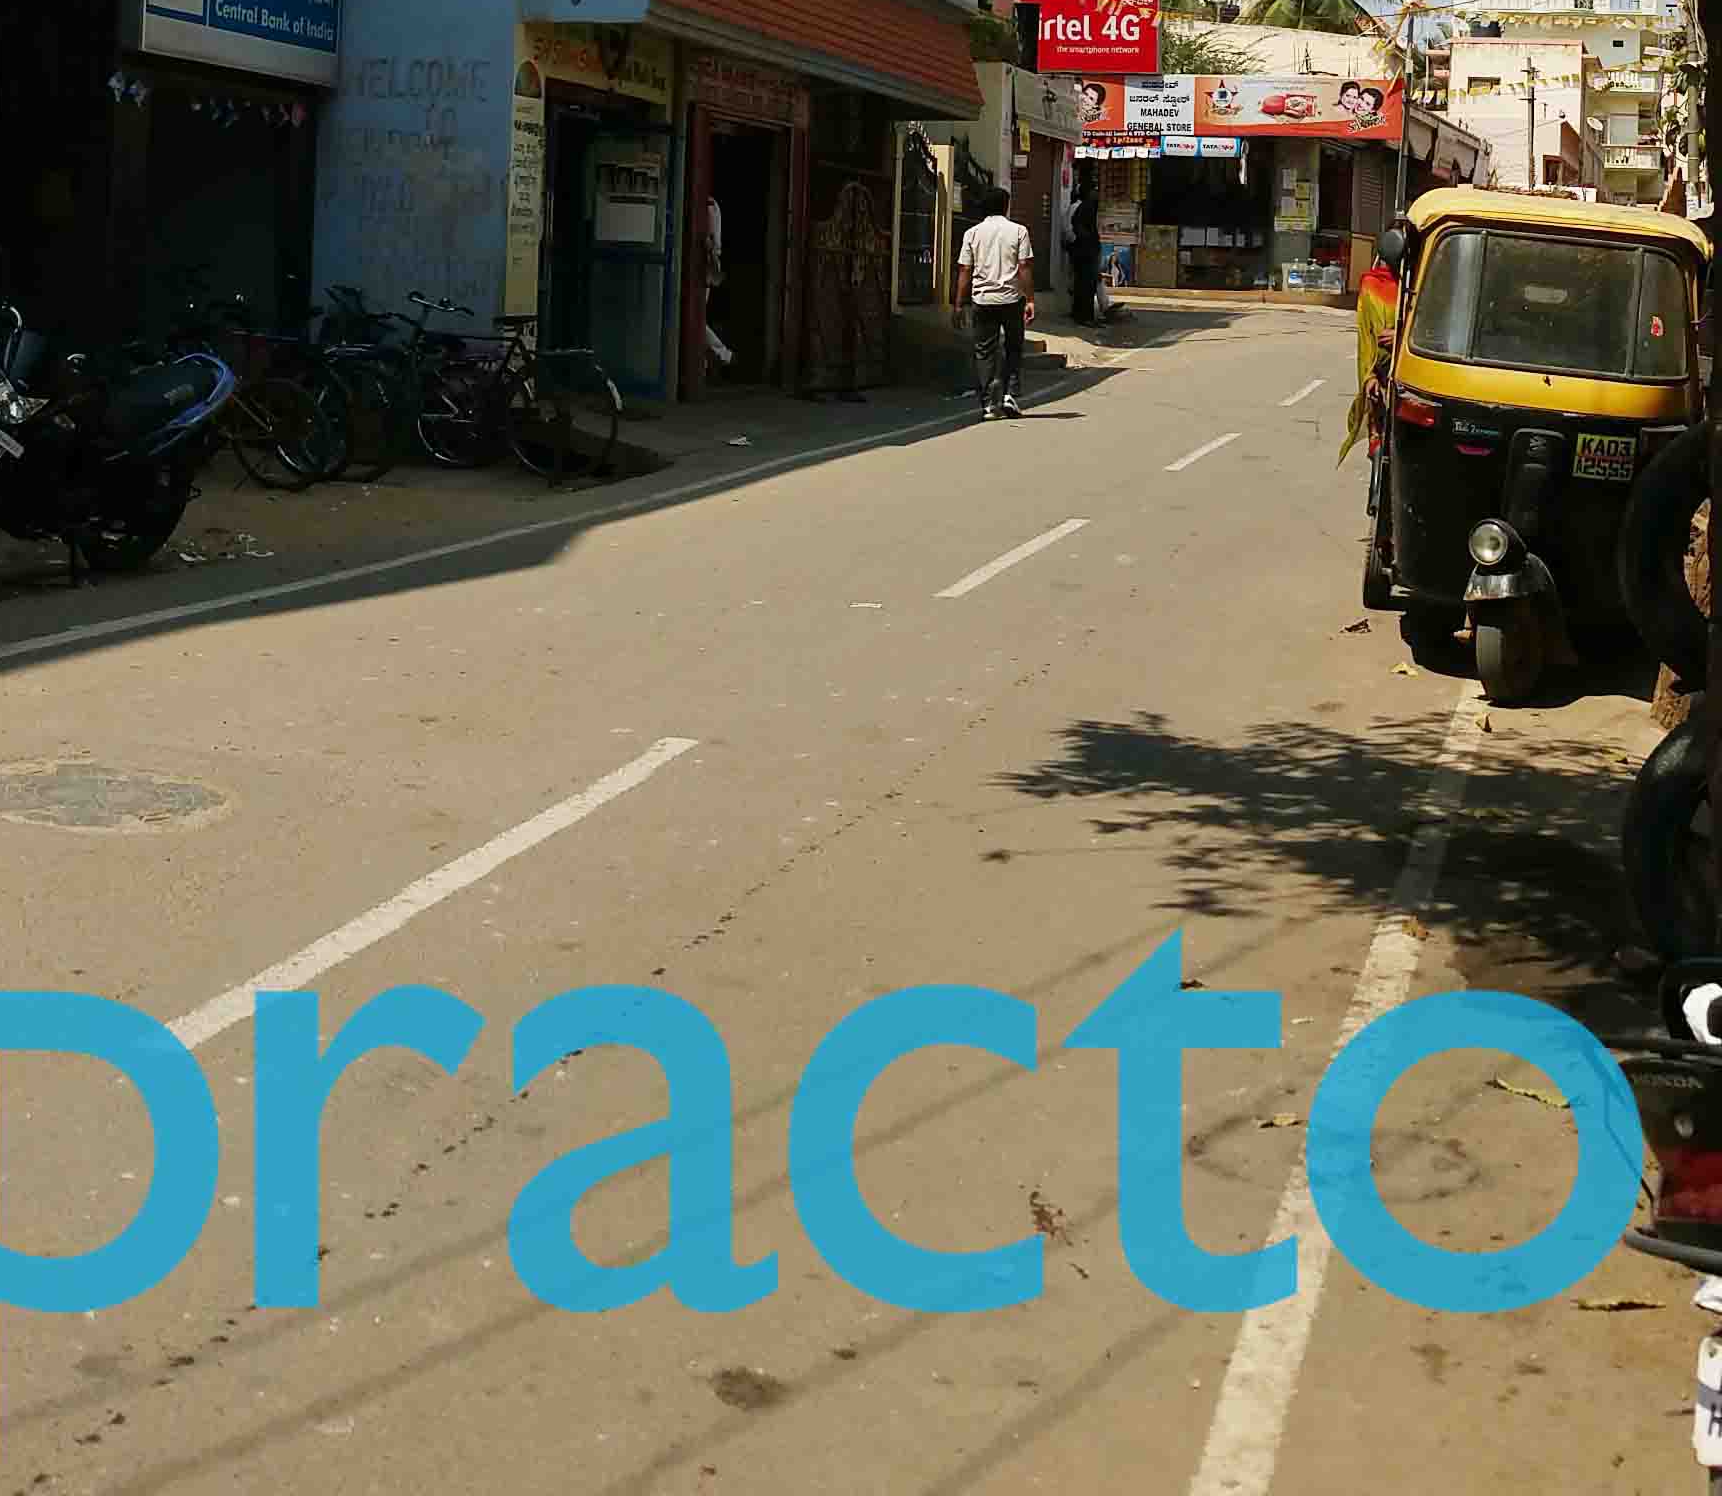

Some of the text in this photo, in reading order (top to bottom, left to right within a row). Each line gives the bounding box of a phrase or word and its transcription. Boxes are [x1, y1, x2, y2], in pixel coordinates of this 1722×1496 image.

[261, 8, 291, 32] Bank
[293, 17, 305, 33] of
[306, 18, 335, 41] India
[1039, 13, 1140, 41] irtel 4G
[1057, 45, 1140, 55] the smartphone network
[1140, 108, 1179, 118] MAHADEV
[1127, 122, 1192, 132] GENERAL STORE
